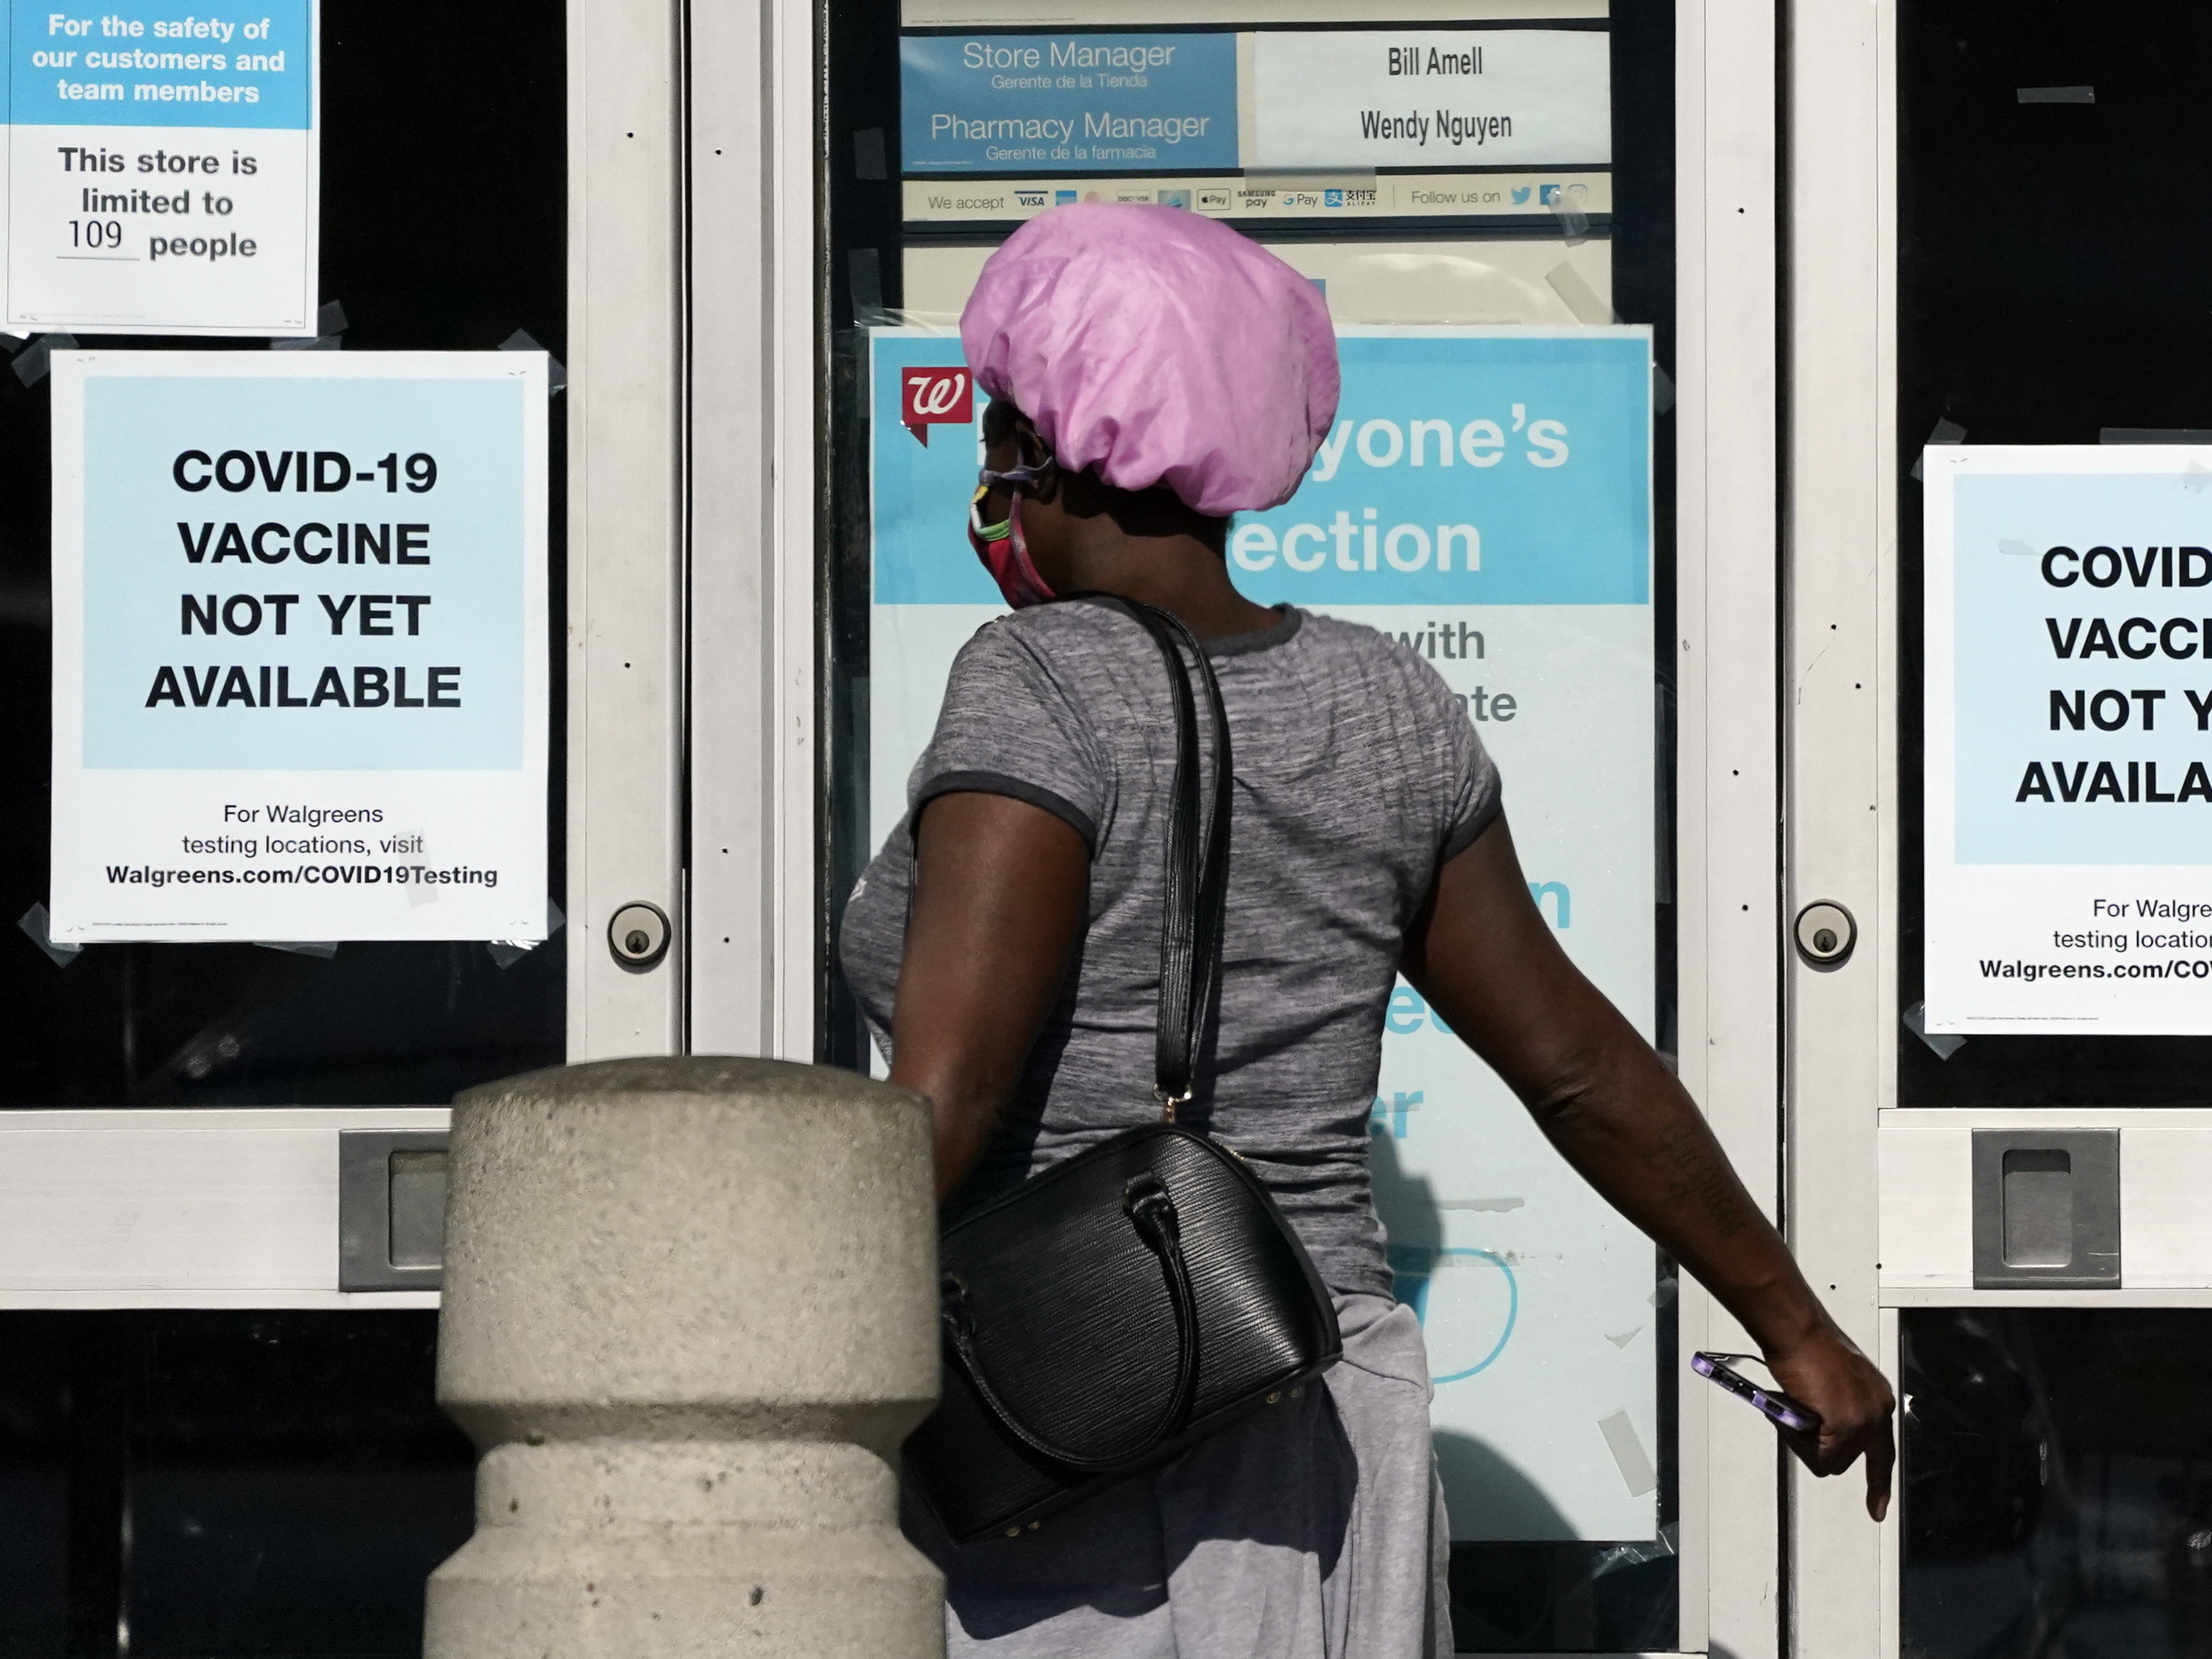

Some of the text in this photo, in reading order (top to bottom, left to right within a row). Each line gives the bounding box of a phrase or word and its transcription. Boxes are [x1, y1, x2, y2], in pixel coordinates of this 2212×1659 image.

[49, 13, 271, 44] For the safety of
[32, 48, 285, 72] our customers and
[963, 41, 1176, 73] Store Manager
[1388, 46, 1483, 76] Bill Amell
[57, 79, 260, 103] team members
[991, 73, 1149, 89] Gerente de la Tienda
[932, 112, 1210, 145] Pharmacy Manager
[1361, 109, 1511, 147] Wendy Nguyen
[57, 147, 257, 175] This store is
[986, 145, 1156, 161] Gerente de la farmacia
[82, 188, 233, 215] limited to
[928, 196, 1005, 211] We accept
[1019, 197, 1045, 206] VISA
[1208, 195, 1226, 205] Pay
[1246, 198, 1267, 208] pay
[1297, 194, 1318, 207] Pay
[1411, 190, 1501, 204] Follow us on
[69, 220, 257, 262] 109 people
[1312, 403, 1570, 482] yone’s
[173, 450, 437, 493] COVID-19
[177, 522, 430, 565] VACCINE
[1231, 507, 1481, 572] ection
[181, 593, 431, 636] NOT YET
[144, 665, 461, 708] AVAILABLE
[2050, 689, 2166, 732] NOT
[224, 804, 383, 828] For Walgreens
[182, 835, 423, 859] testing locations, visit
[106, 865, 498, 888] Walgreens.com/COVID19Testing
[2094, 899, 2130, 918] For
[2053, 930, 2127, 953] testing
[1980, 960, 2212, 981] Walgreens.com/CO
